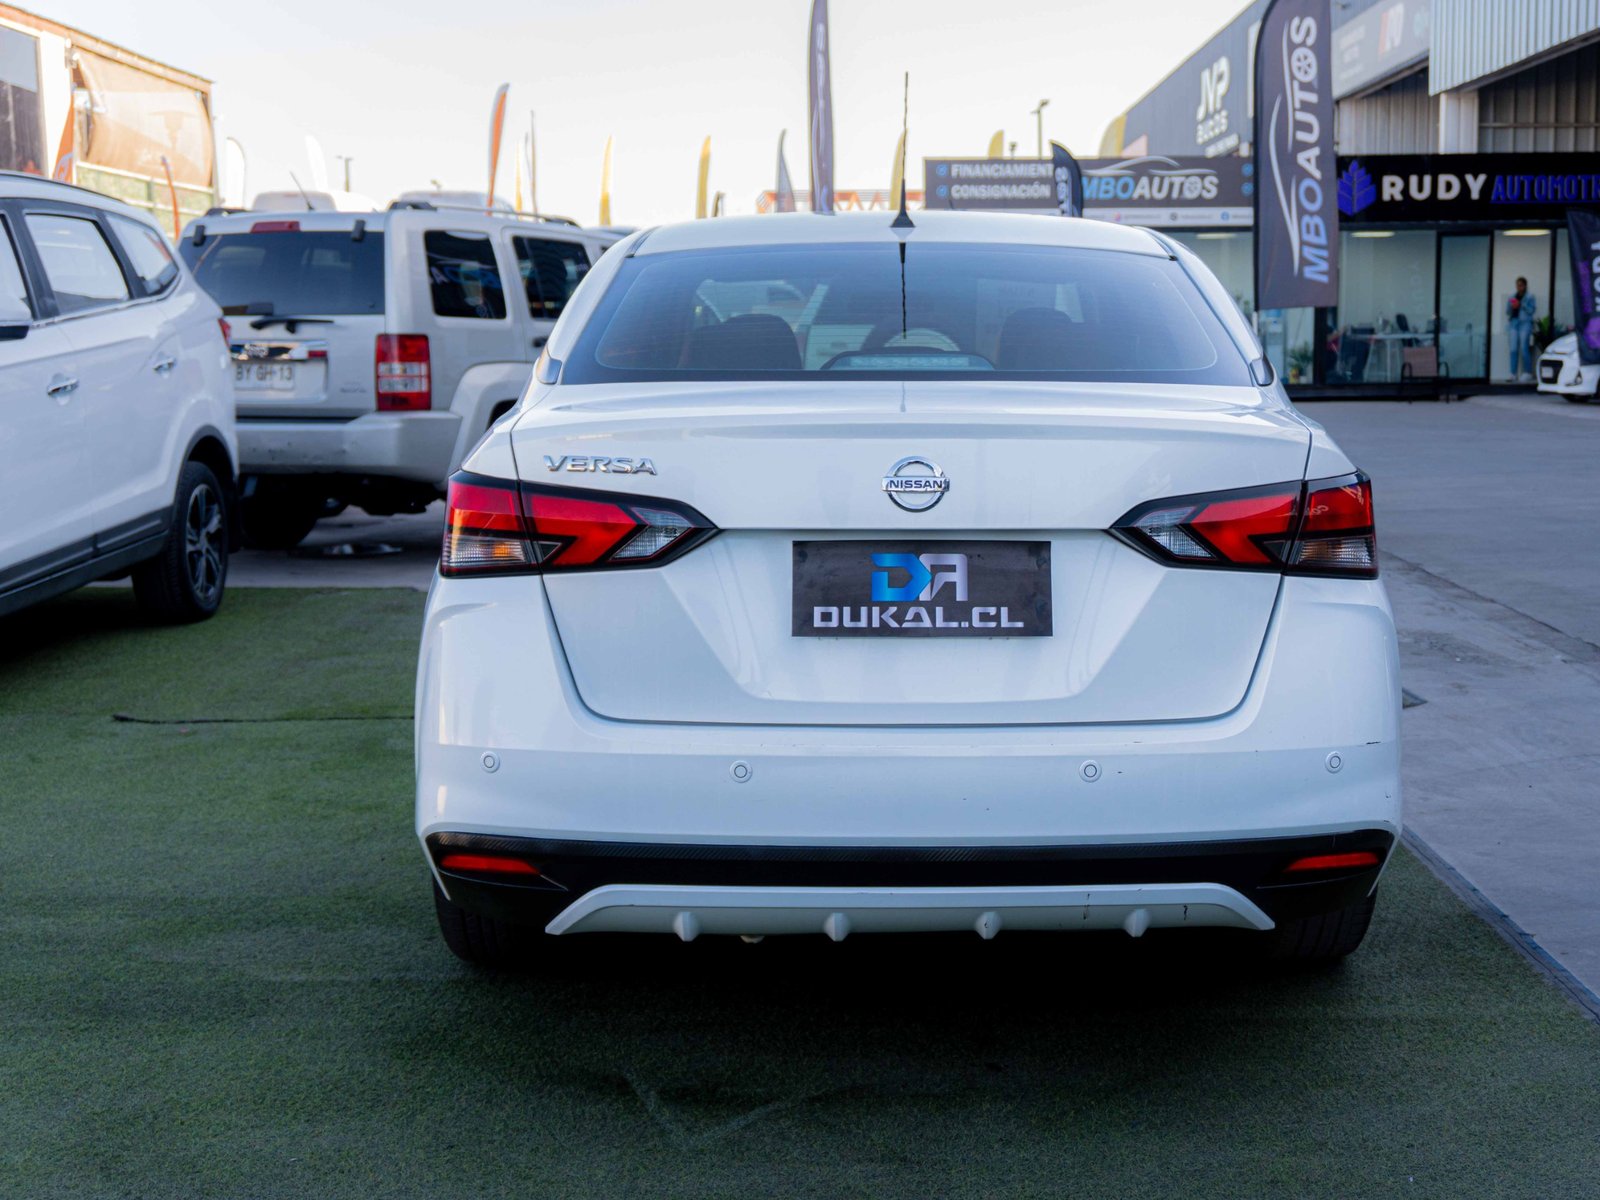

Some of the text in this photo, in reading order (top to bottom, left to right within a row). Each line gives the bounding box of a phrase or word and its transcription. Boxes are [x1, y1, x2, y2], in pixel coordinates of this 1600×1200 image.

[1290, 15, 1330, 284] MBOAUTOS
[950, 181, 1051, 199] CONSIGNACIÓN
[1381, 174, 1488, 201] RUDY
[543, 455, 658, 476] VERSA
[889, 480, 943, 489] NISSAN
[812, 605, 1025, 628] DUKAL.CL
